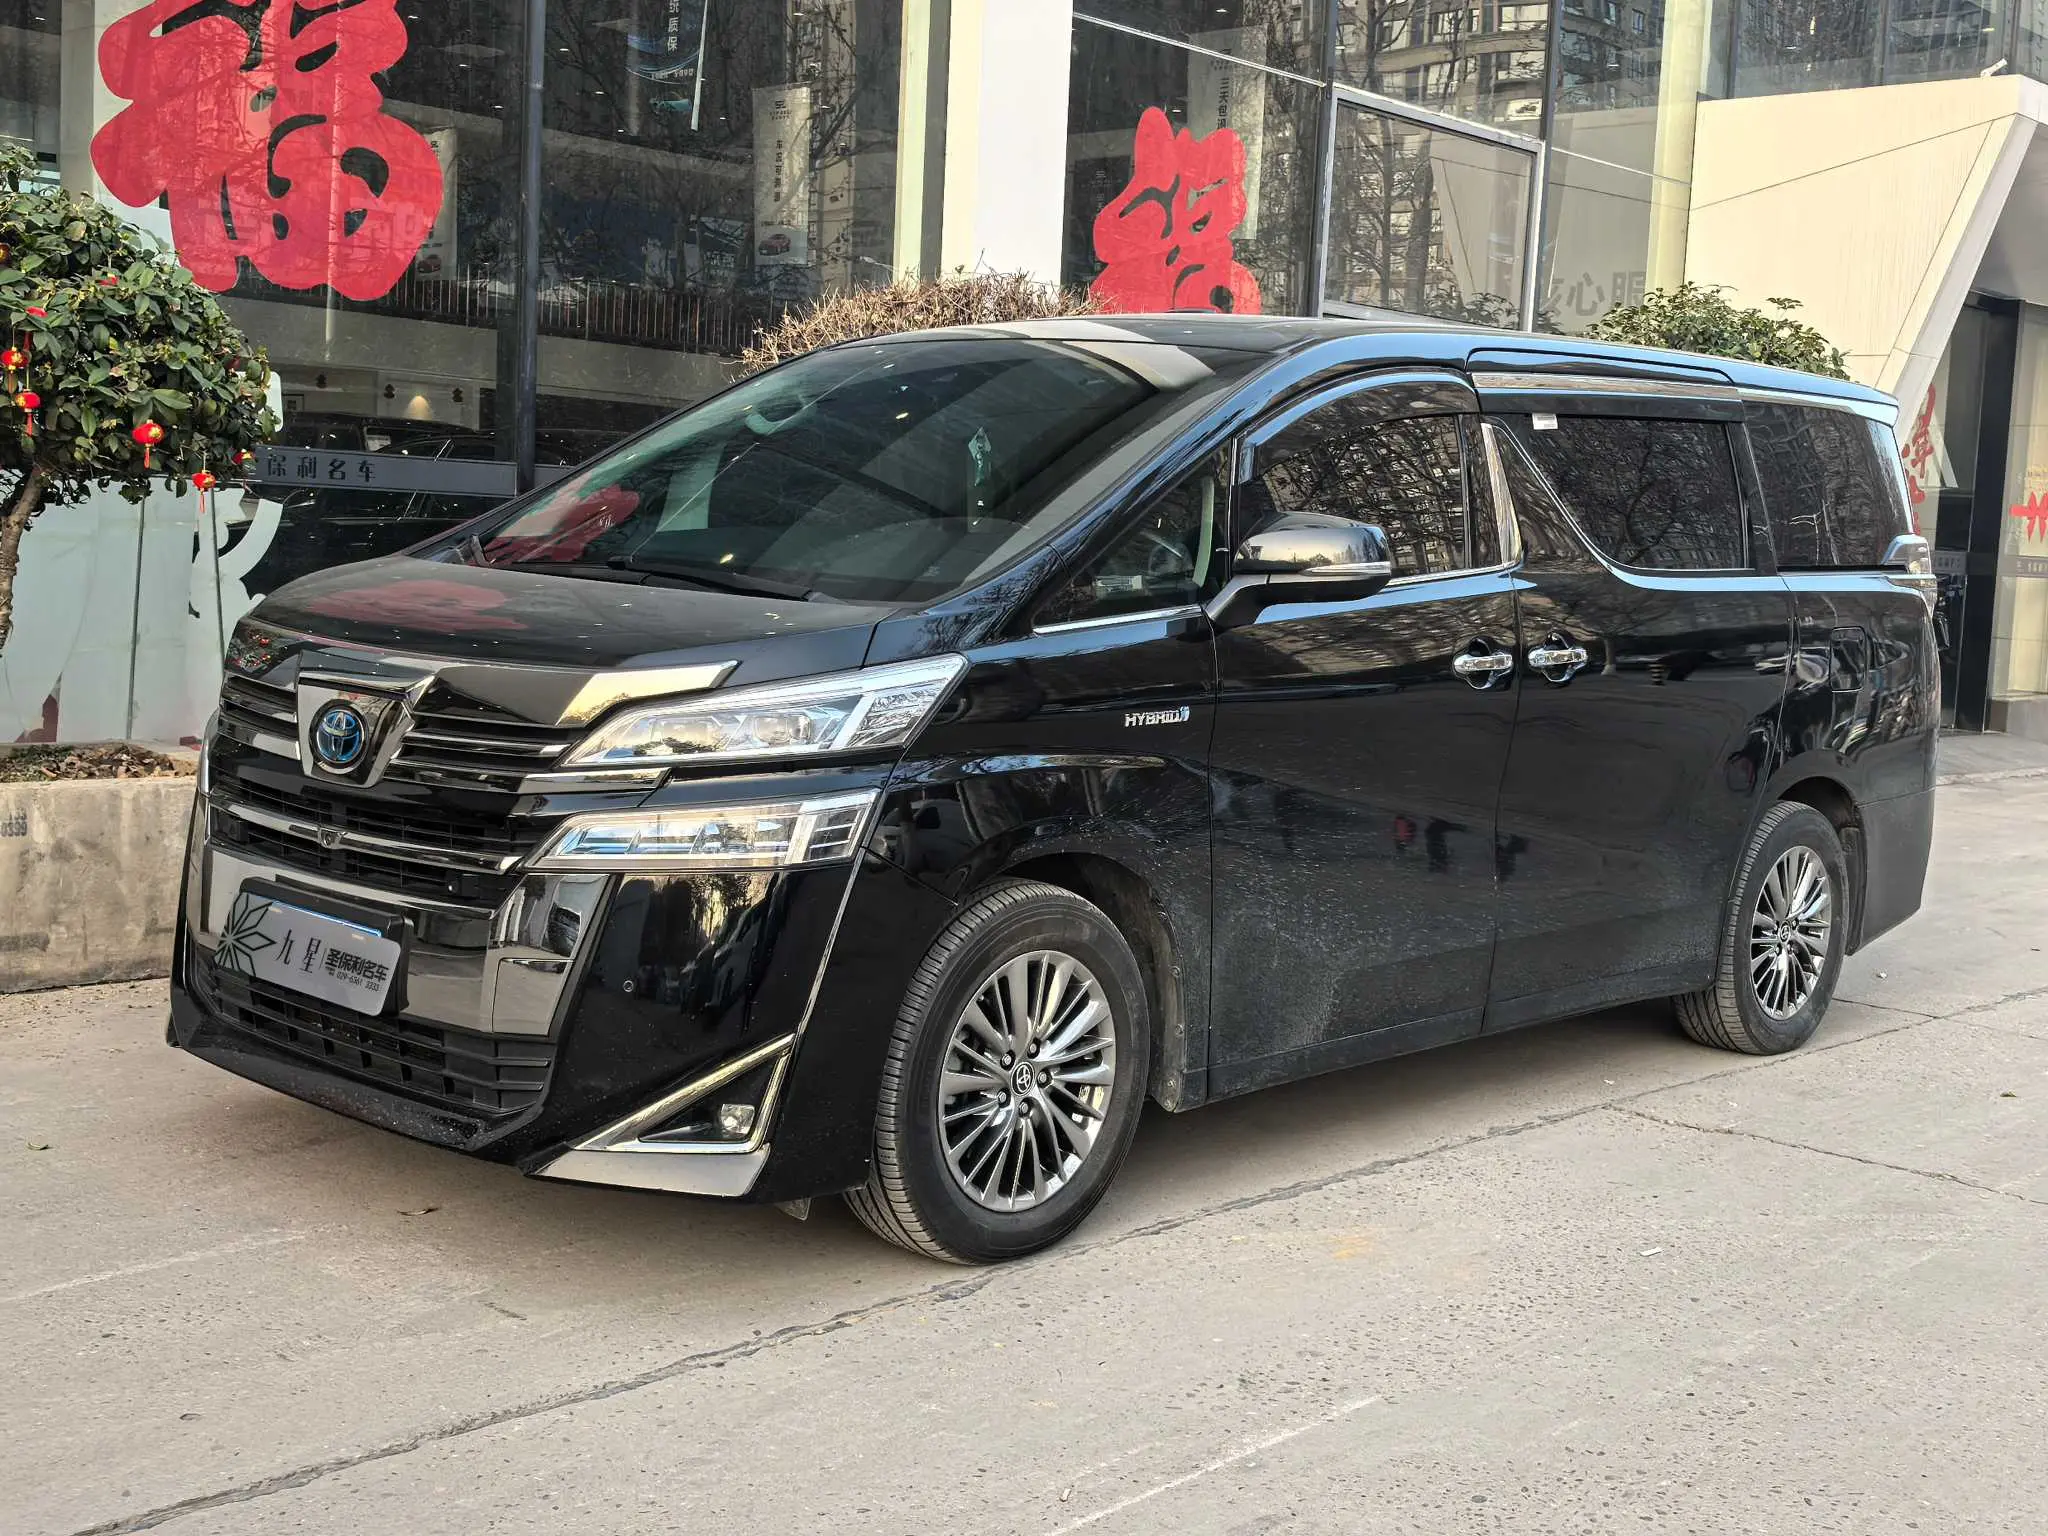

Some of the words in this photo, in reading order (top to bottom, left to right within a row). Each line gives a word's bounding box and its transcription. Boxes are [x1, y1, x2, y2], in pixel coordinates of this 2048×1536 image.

[90, 0, 444, 301] 福
[1124, 708, 1182, 728] HYBRID
[275, 929, 321, 974] 九星
[325, 947, 390, 983] 圣保利名车
